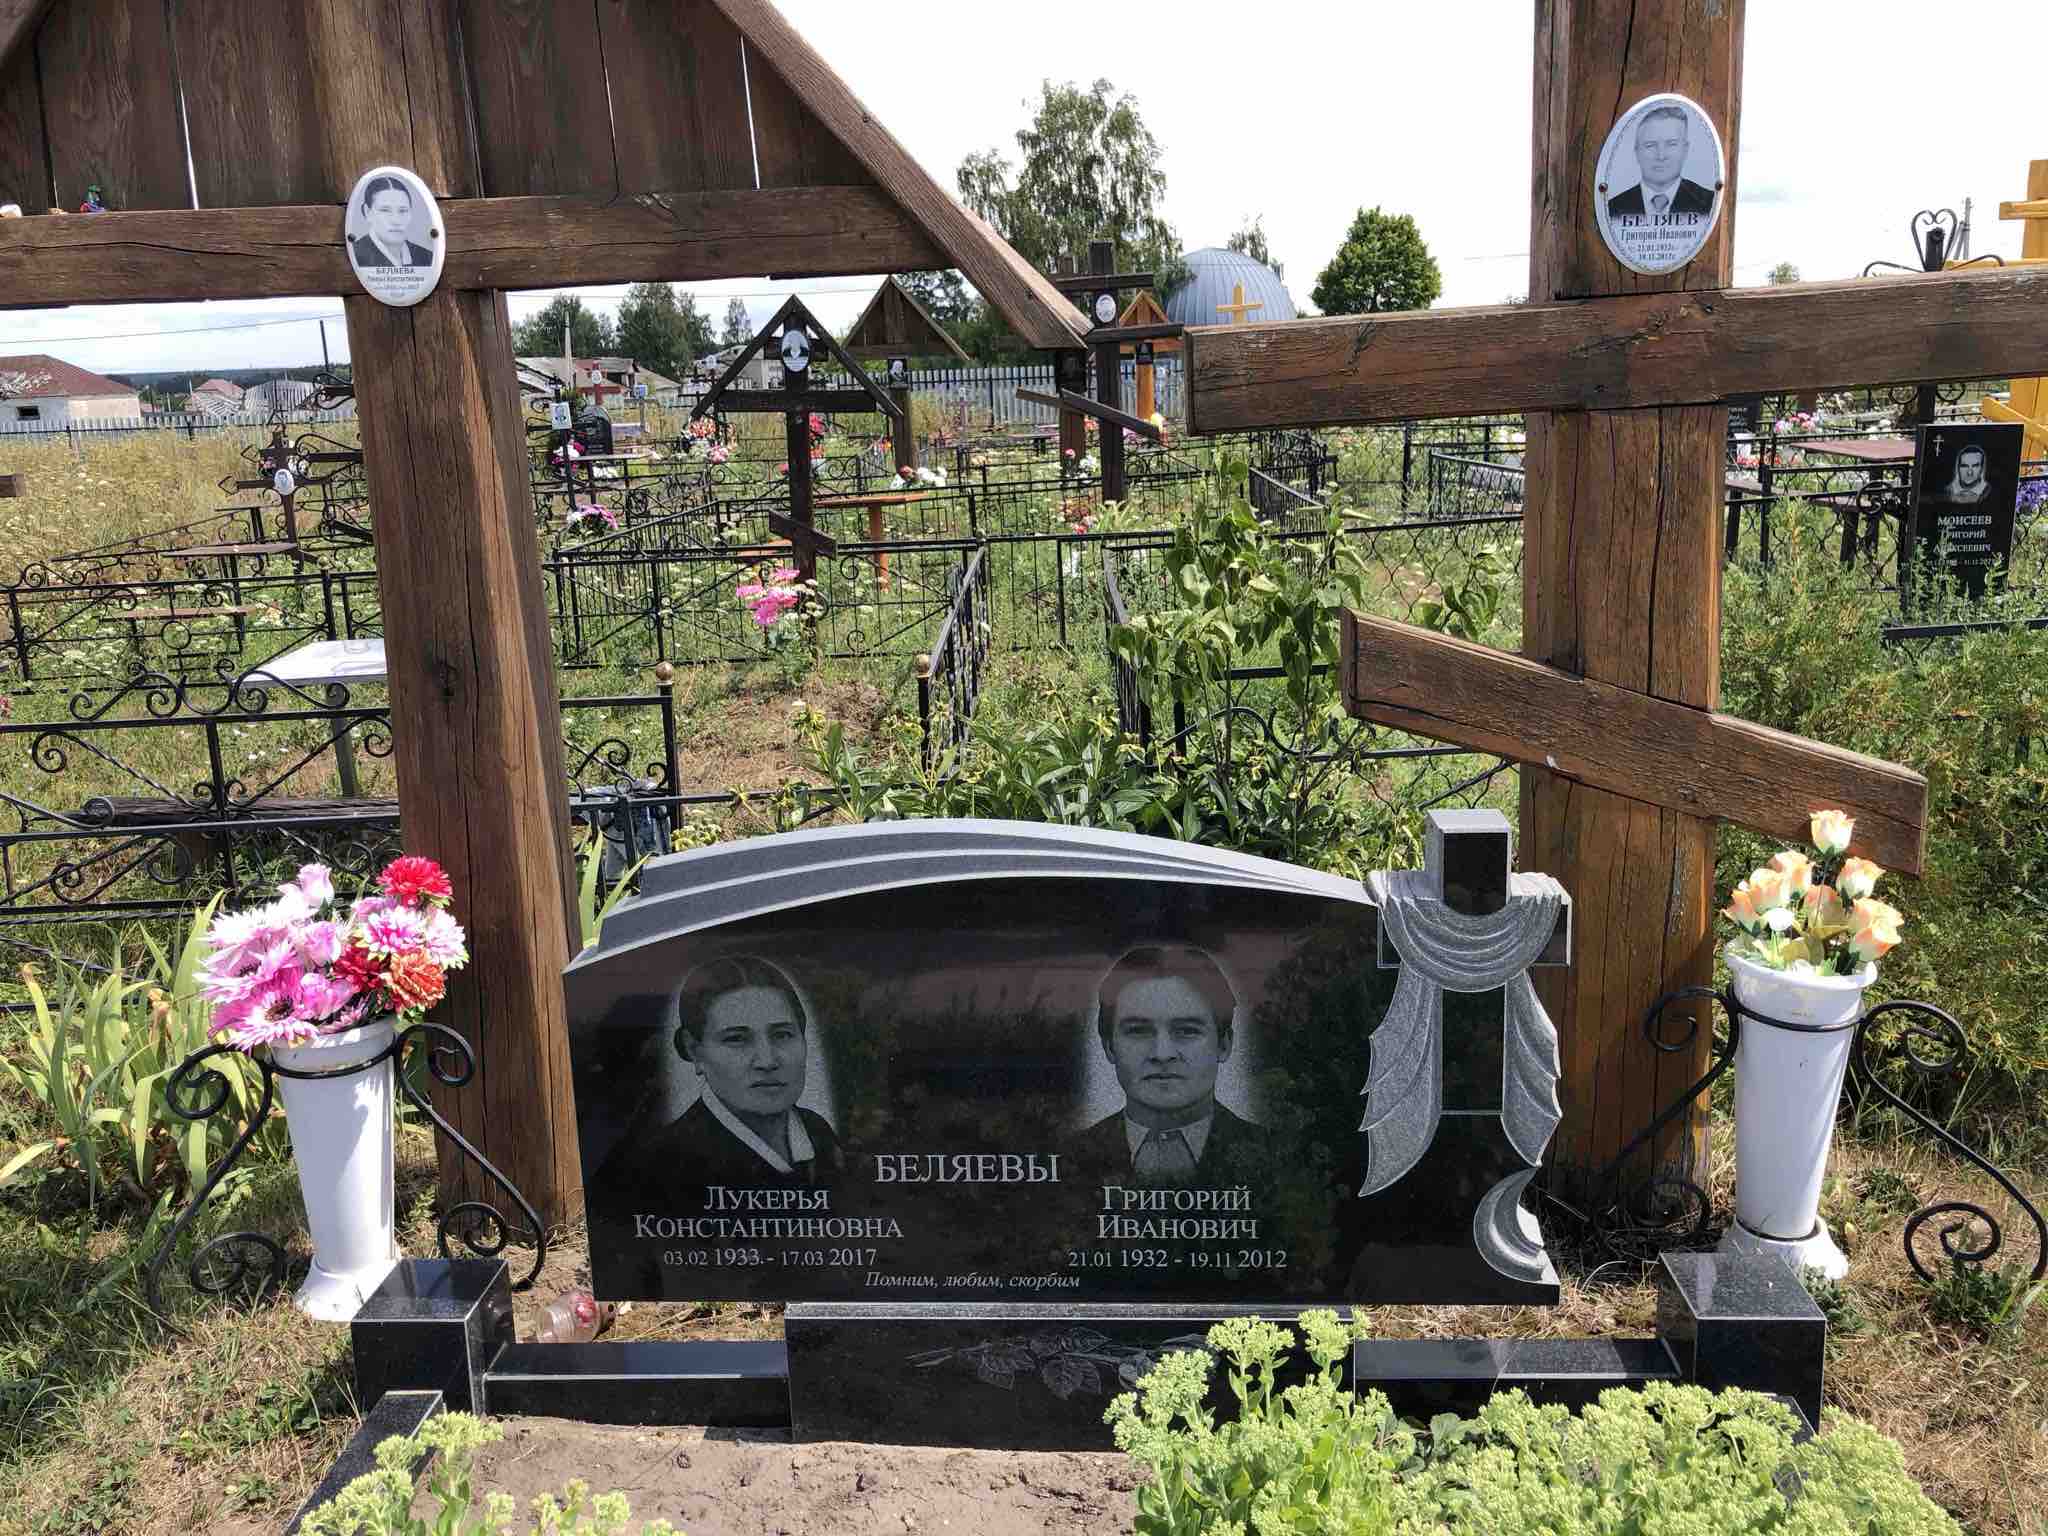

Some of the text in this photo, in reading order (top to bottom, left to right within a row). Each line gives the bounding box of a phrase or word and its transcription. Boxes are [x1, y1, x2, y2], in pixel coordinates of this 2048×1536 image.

[1622, 214, 1699, 227] БЕЛЯЕВ
[1621, 229, 1657, 243] Григорий
[1937, 515, 1993, 526] МОИСЕЕВ
[874, 1154, 1062, 1183] БЕЛЯЕВЫ
[663, 1250, 708, 1266] 03.02
[782, 1250, 824, 1266] 17.03
[829, 1247, 877, 1266] 2017
[1067, 1250, 1113, 1267] 21.01
[1120, 1249, 1168, 1268] 1932
[1190, 1251, 1231, 1268] 19.11
[1238, 1249, 1287, 1268] 2012
[865, 1271, 1080, 1290] Помним, любим, скорбим
